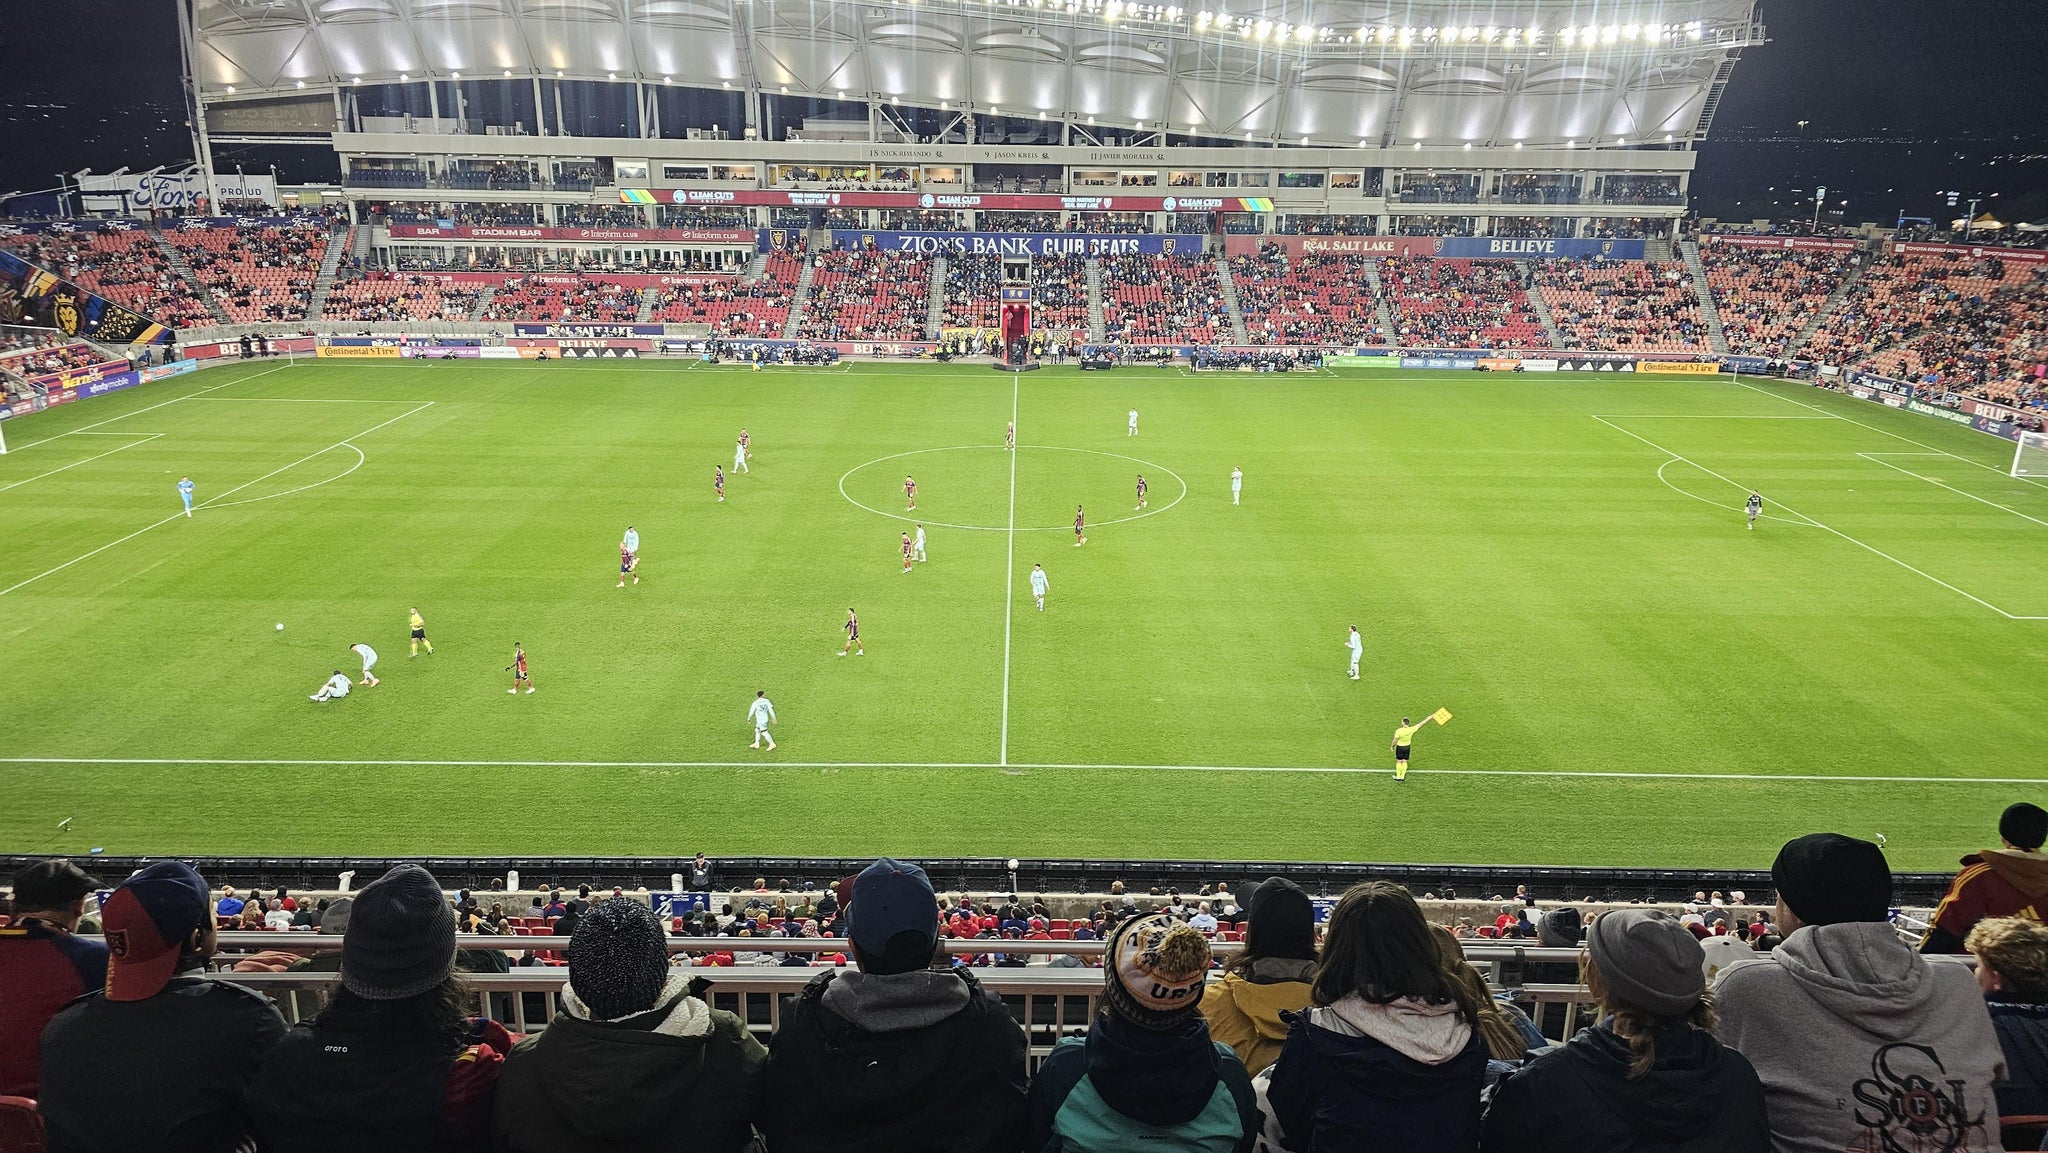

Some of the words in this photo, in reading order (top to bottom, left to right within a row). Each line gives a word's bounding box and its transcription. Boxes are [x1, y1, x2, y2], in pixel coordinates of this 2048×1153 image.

[689, 191, 713, 200] CLEAN
[714, 192, 735, 200] CUTS
[936, 196, 960, 204] CLEAN
[962, 196, 981, 204] CUTS
[1203, 198, 1222, 207] CUTS
[52, 222, 76, 232] Ford
[106, 220, 132, 231] Ford
[184, 218, 208, 230] Ford
[591, 230, 621, 238] Interform
[692, 231, 722, 239] Interform
[898, 236, 965, 253] ZIONS
[972, 237, 1034, 255] BANK
[1042, 238, 1085, 255] CLUB
[1092, 238, 1139, 255] SEATS
[1333, 240, 1361, 250] SALT
[1363, 241, 1394, 251] LAKE
[1490, 239, 1556, 254] BELIEVE
[324, 346, 369, 356] Continental
[376, 346, 394, 355] Tire
[1644, 362, 1689, 372] Continental
[1696, 364, 1713, 372] Tire
[90, 382, 108, 394] xfinity
[108, 377, 129, 388] mobile
[1908, 400, 1934, 414] ALSCO
[1934, 407, 1972, 425] UNIFORMS
